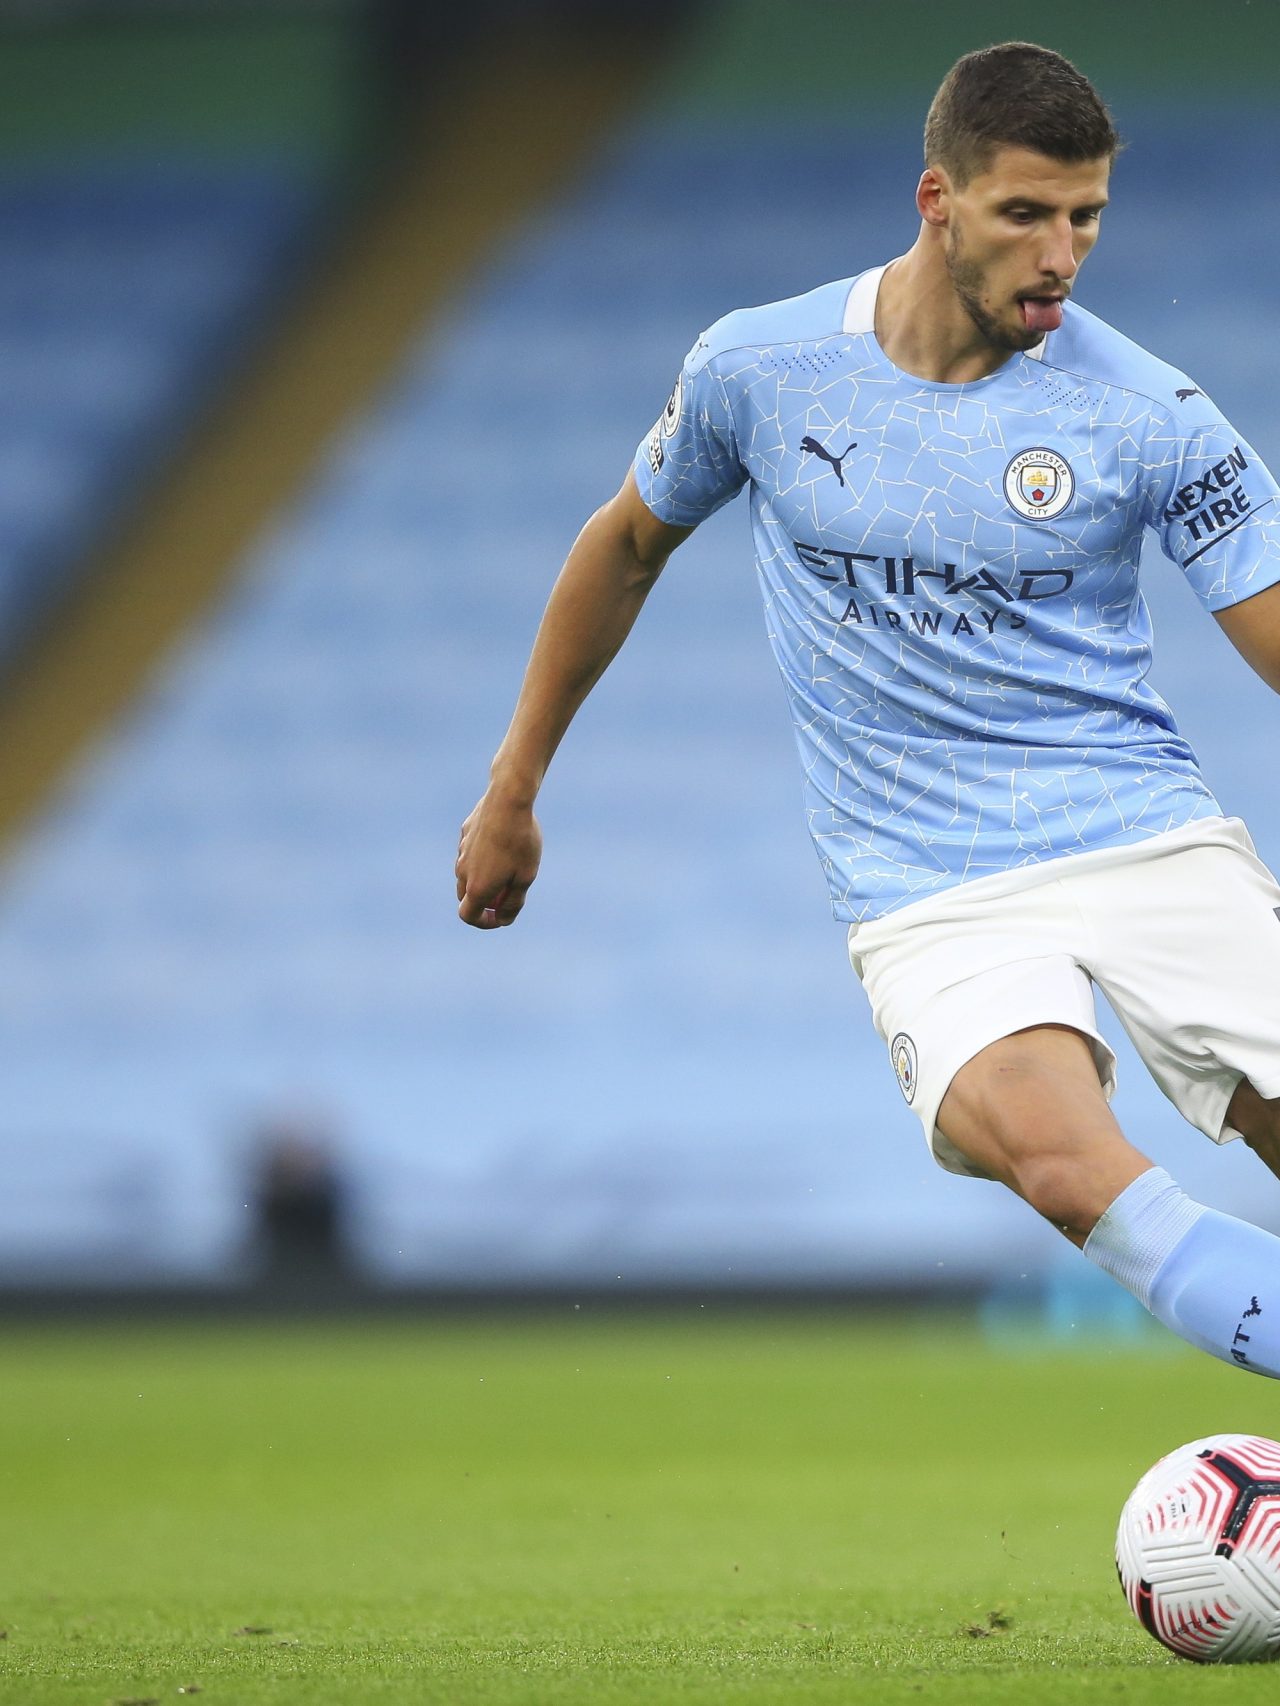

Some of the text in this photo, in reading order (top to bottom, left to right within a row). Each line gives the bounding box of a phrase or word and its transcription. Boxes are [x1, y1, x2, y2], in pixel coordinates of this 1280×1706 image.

[1011, 453, 1068, 476] MANCHESTER
[1164, 446, 1248, 523] NEXEN
[1184, 485, 1251, 541] TIRE
[793, 542, 1073, 602] ETIHAD
[841, 598, 1026, 635] AIRWAYS
